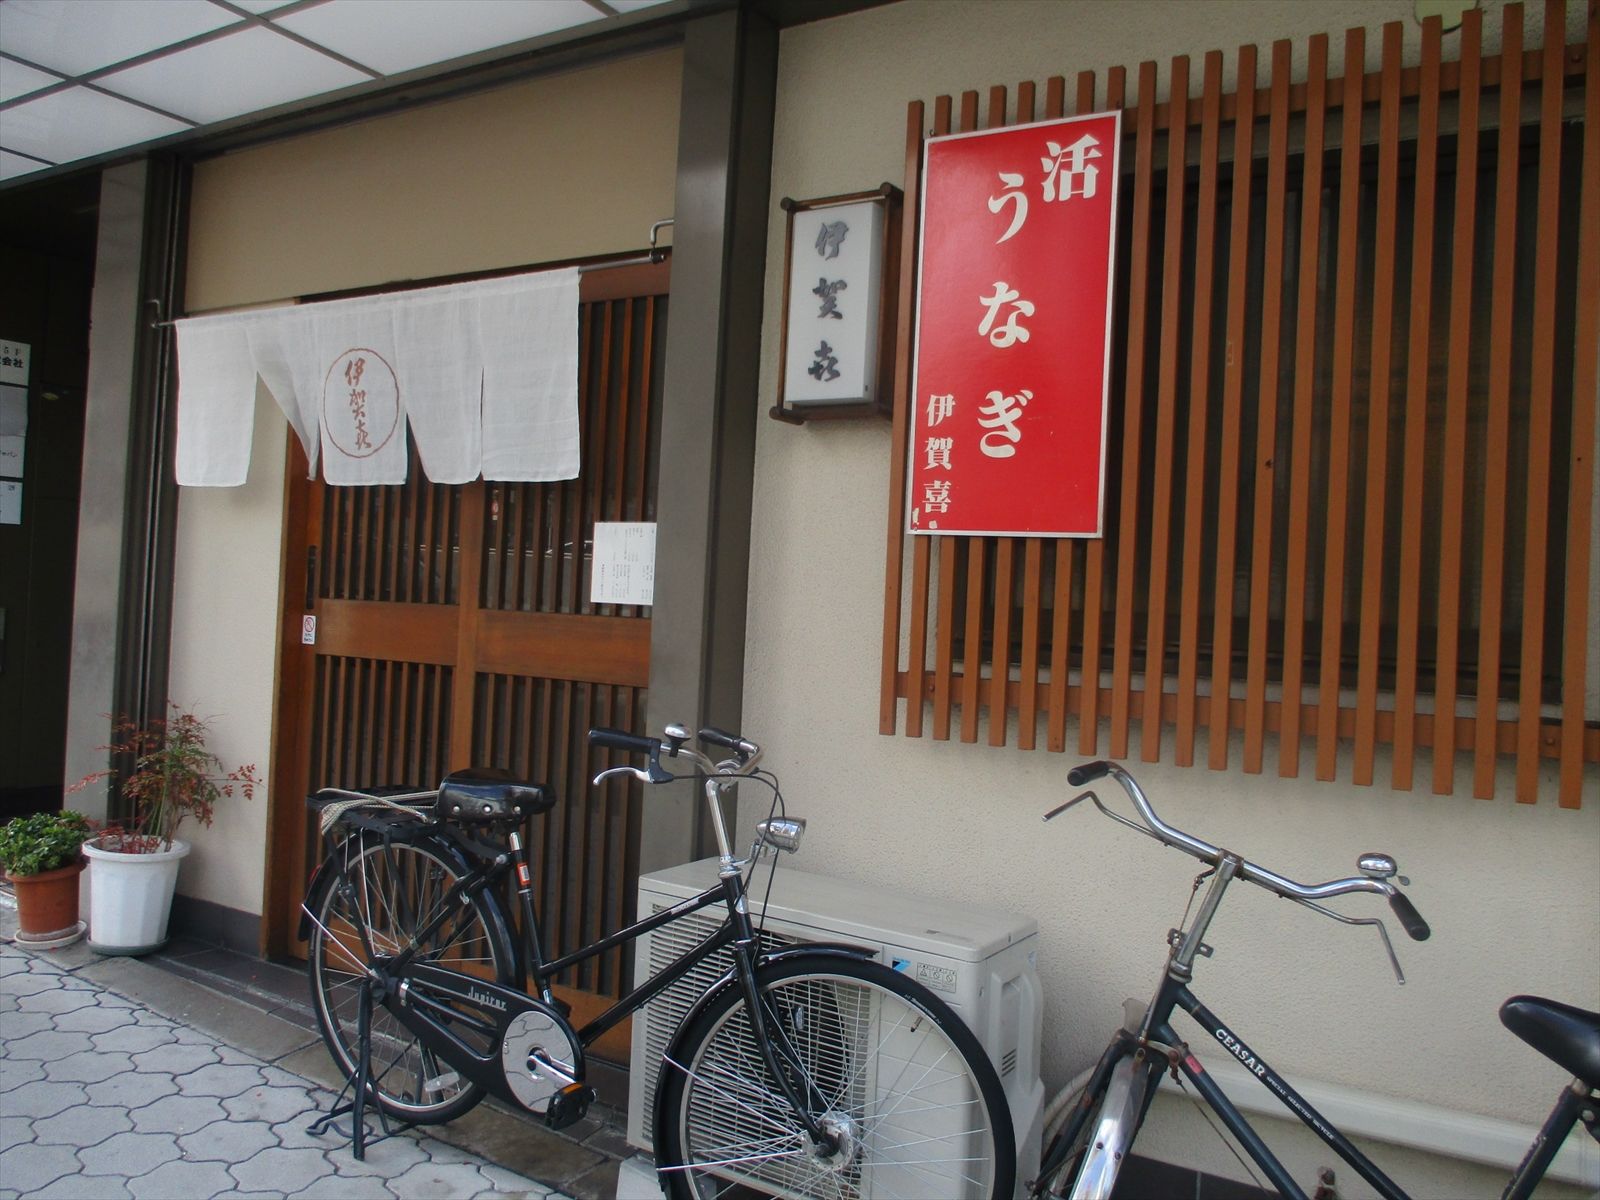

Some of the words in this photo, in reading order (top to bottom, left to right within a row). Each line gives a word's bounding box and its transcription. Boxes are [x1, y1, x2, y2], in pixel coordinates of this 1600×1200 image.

[1041, 133, 1103, 203] 活
[976, 171, 1036, 459] うなぎ
[0, 355, 24, 369] 会社
[922, 393, 957, 514] 伊賀喜
[1215, 1028, 1266, 1077] CEASAR
